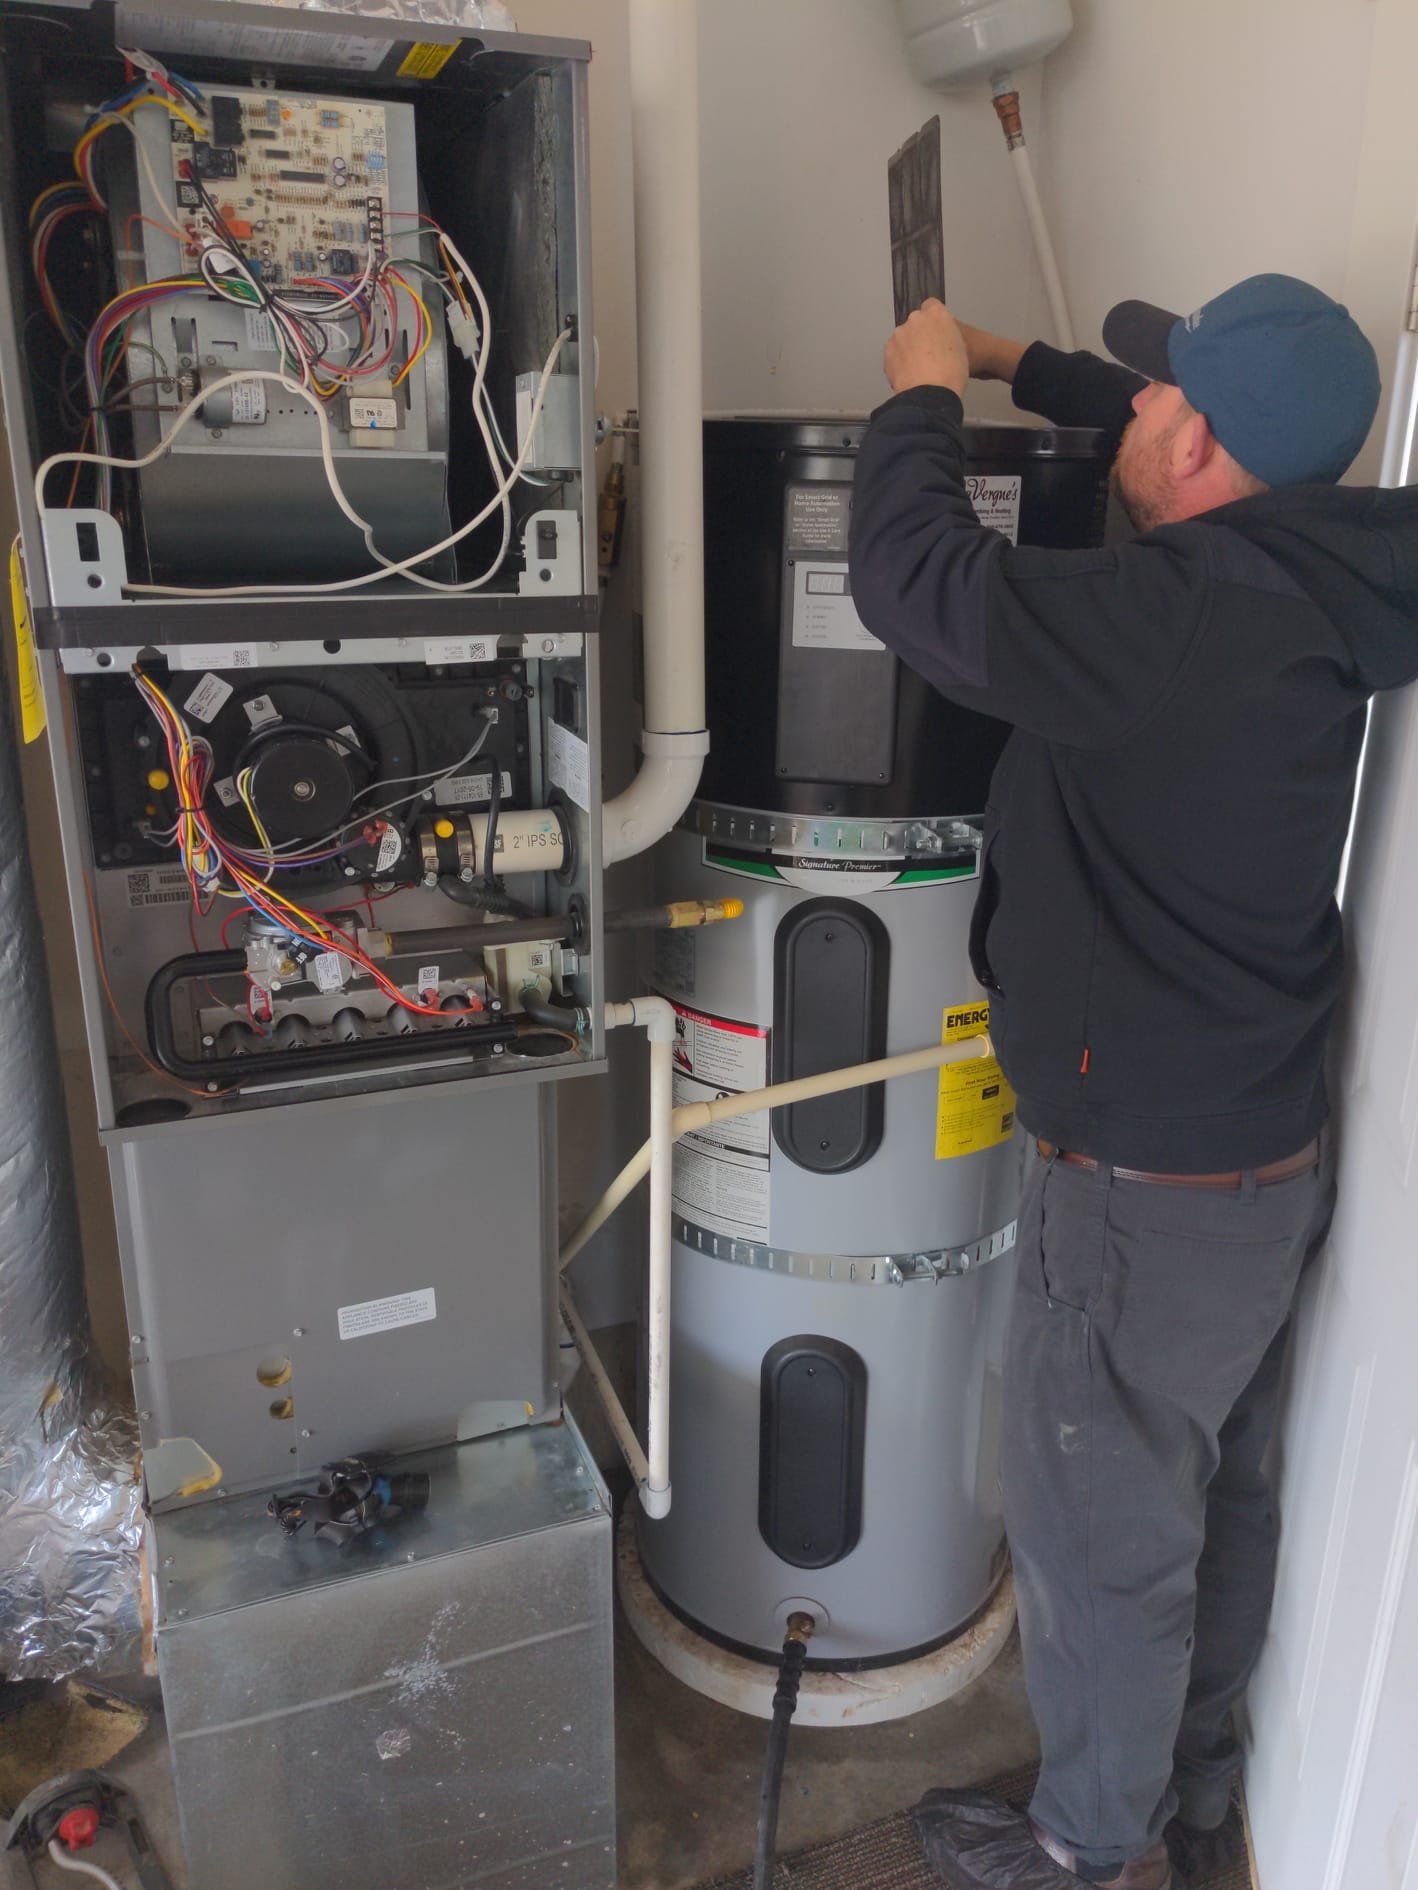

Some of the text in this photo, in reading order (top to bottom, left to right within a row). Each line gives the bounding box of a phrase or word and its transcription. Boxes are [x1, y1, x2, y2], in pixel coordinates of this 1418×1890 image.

[527, 833, 547, 848] IPS
[798, 858, 877, 872] Signature Premier
[687, 1011, 712, 1026] DANGER
